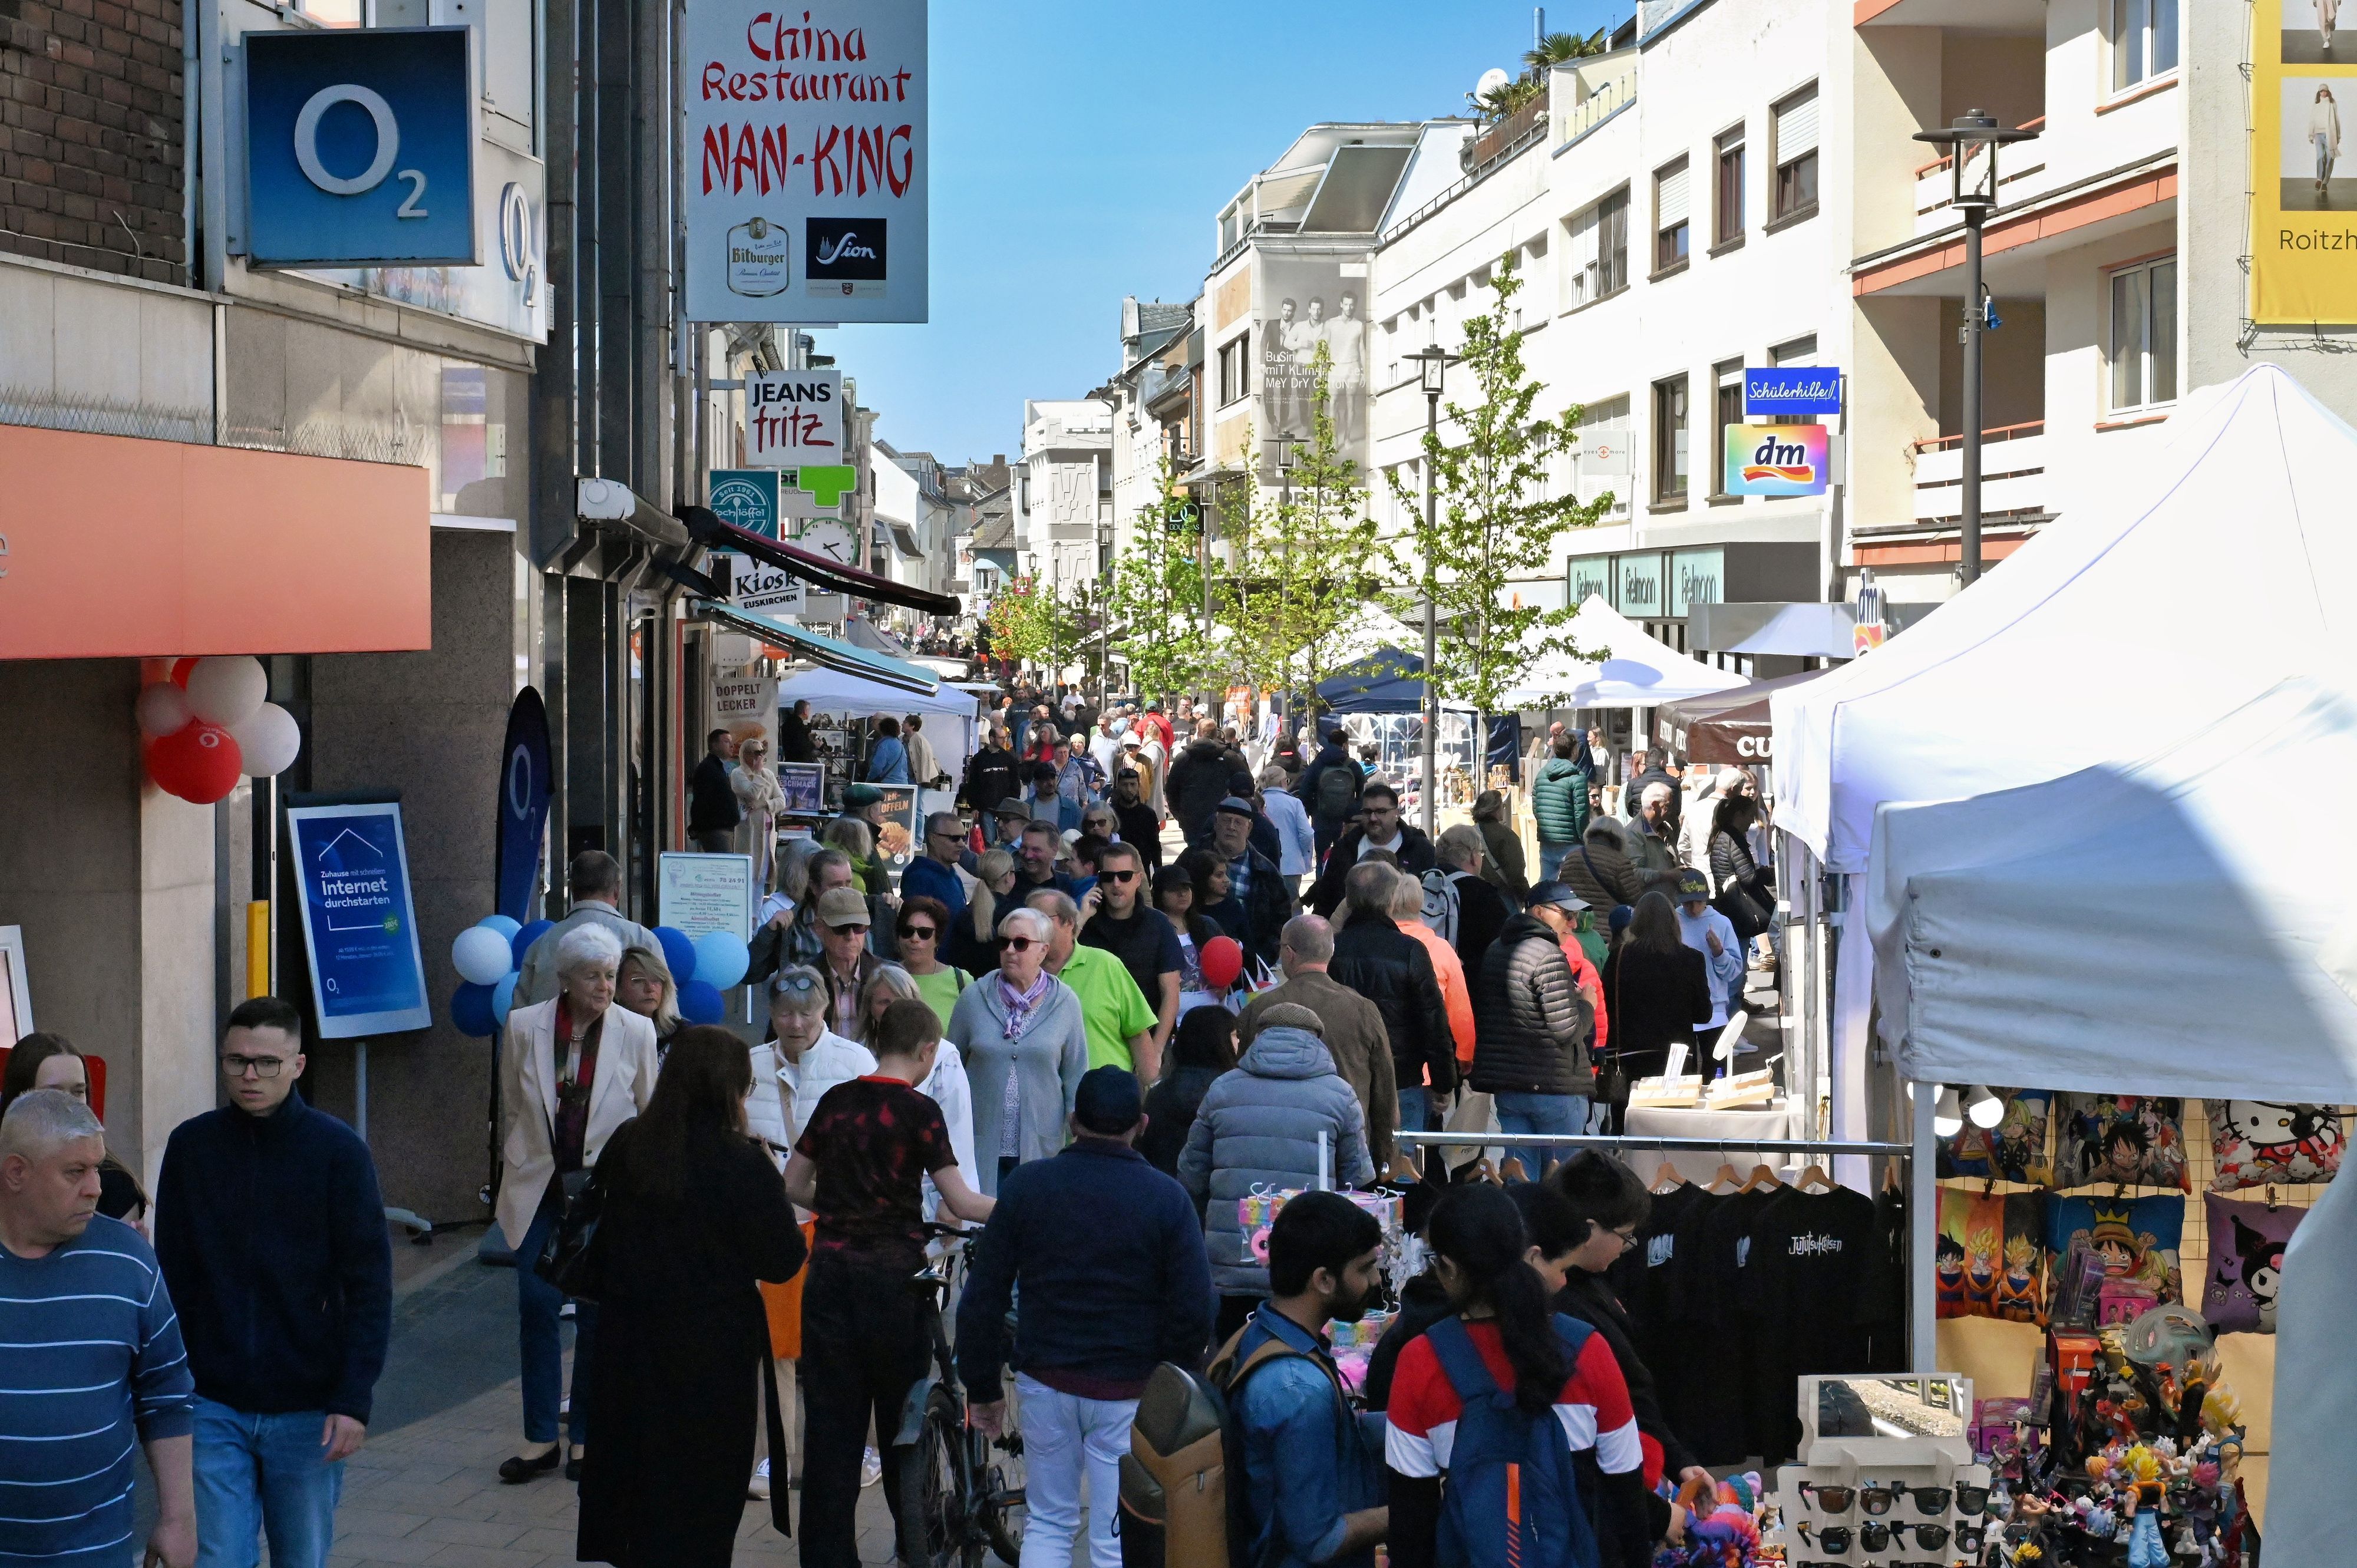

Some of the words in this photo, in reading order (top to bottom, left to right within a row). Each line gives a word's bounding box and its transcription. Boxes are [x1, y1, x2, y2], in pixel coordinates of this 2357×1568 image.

[747, 10, 867, 62] China
[702, 61, 912, 103] Restaurant
[703, 120, 913, 199] NAN-KING
[732, 247, 785, 266] Bitburger
[816, 232, 877, 265] Sion
[752, 382, 831, 407] JEANS
[752, 405, 834, 453] fritz
[1755, 436, 1805, 466] dm
[718, 486, 734, 498] Seit
[712, 507, 765, 519] ochlöffel
[735, 572, 800, 596] Kiosk
[744, 594, 798, 609] EUSKIRCHEN
[1858, 573, 1878, 625] dm
[716, 684, 761, 697] DOPPELT
[717, 699, 756, 712] LECKER
[881, 800, 909, 813] OFFELN
[322, 877, 388, 896] Internet
[325, 896, 391, 909] durchstarten
